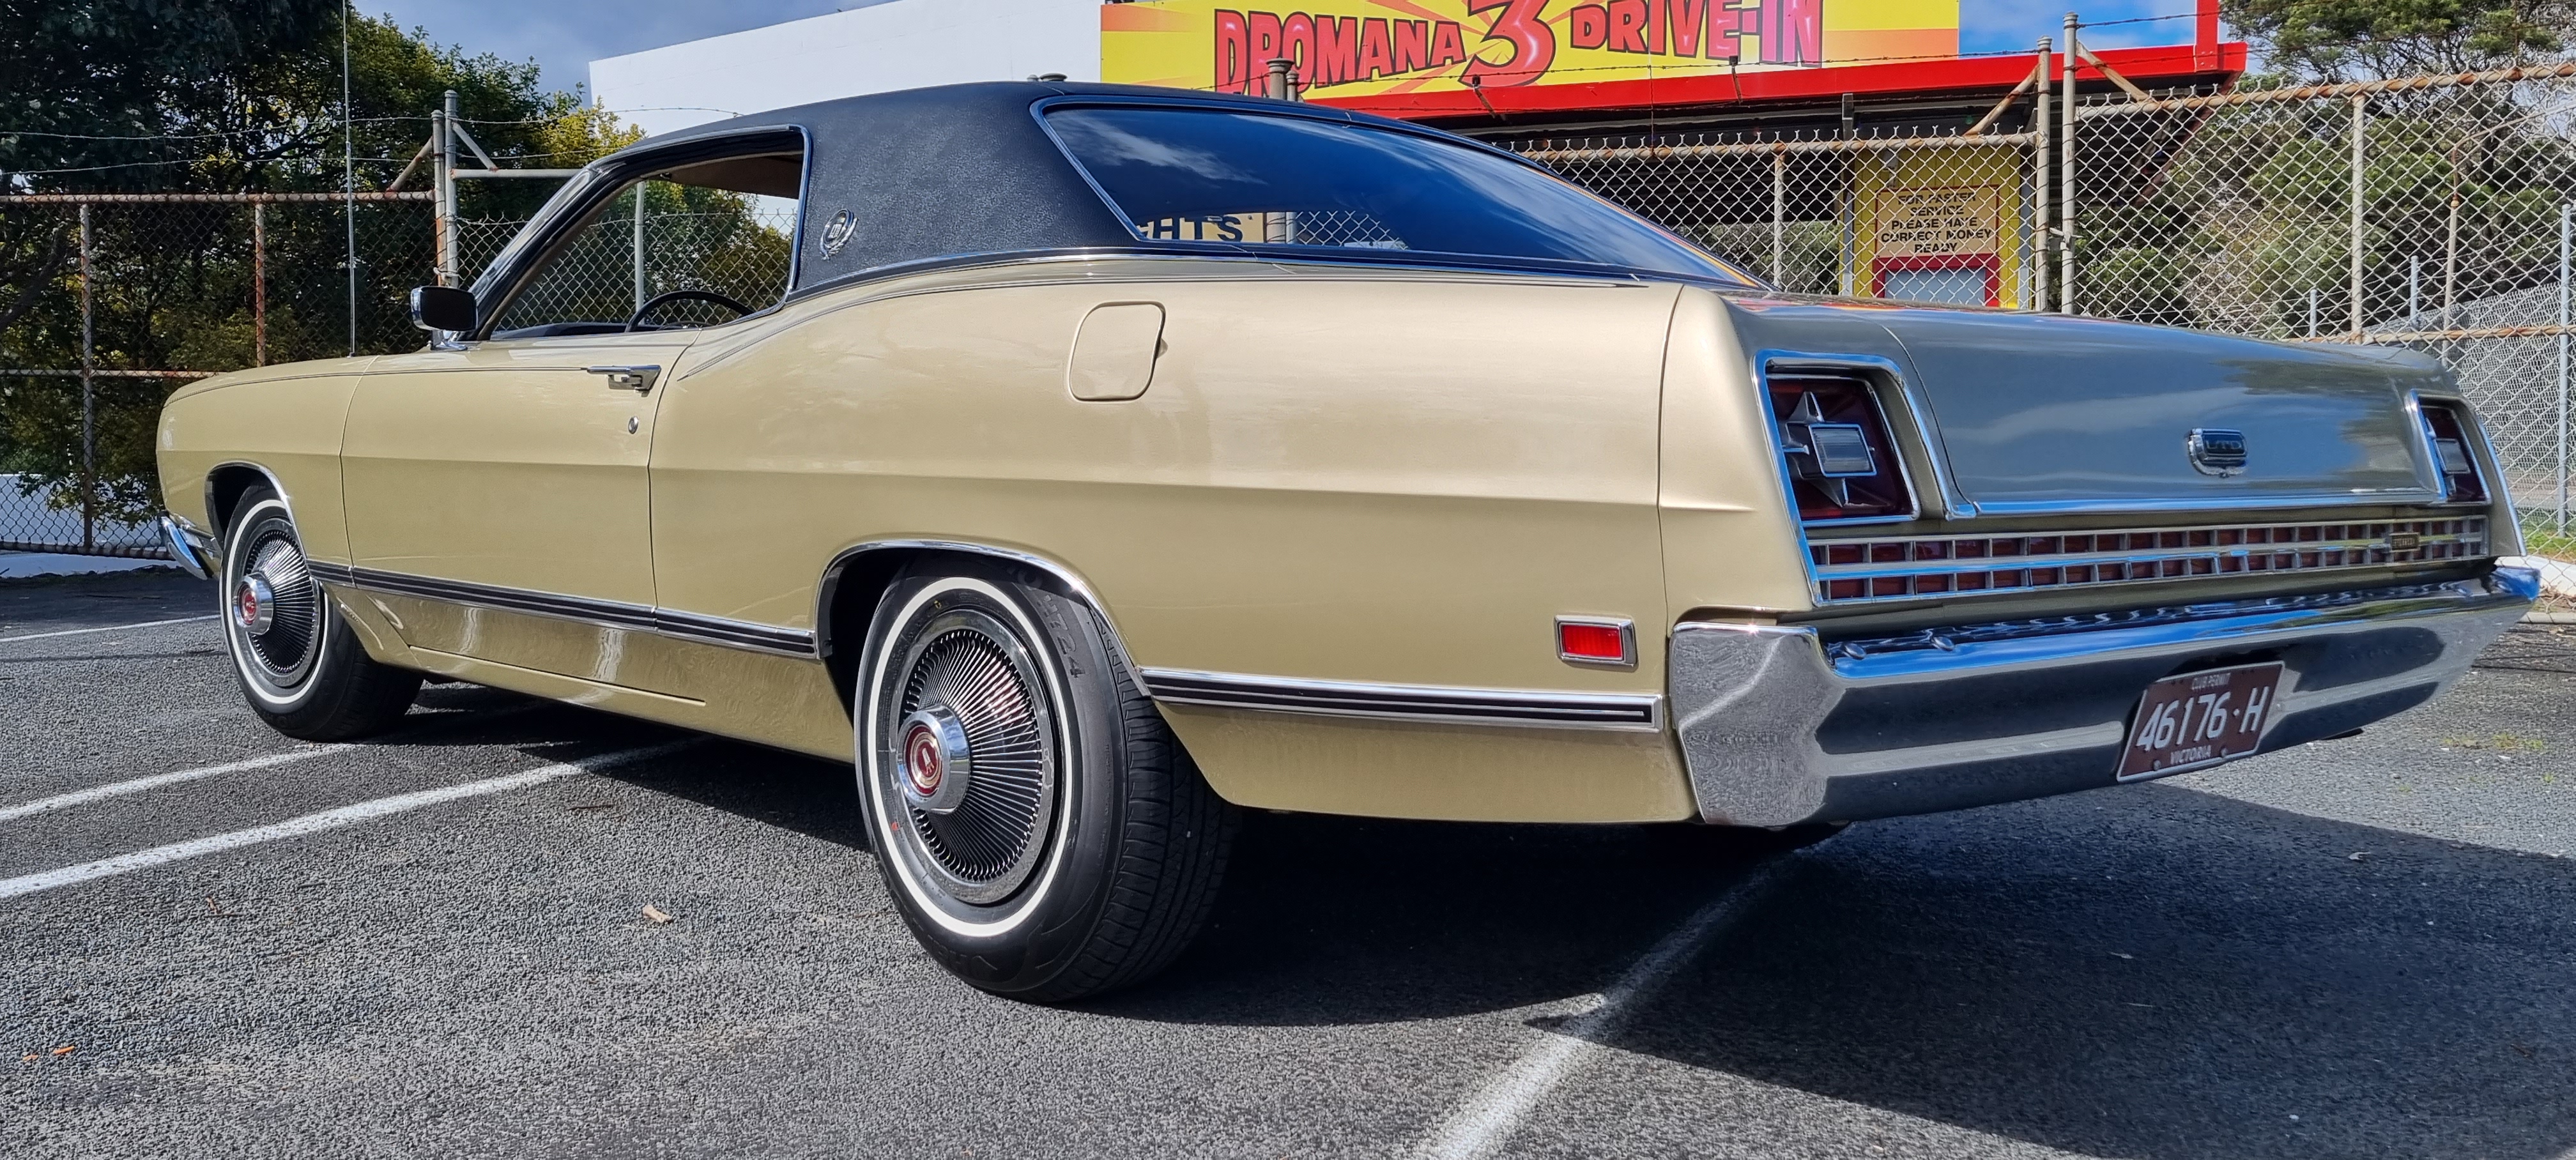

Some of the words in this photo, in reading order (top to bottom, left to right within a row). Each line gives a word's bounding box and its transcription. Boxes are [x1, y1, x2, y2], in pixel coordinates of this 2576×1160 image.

[1215, 9, 1466, 97] DROMANA
[1459, 0, 1556, 88] 3
[1570, 0, 1823, 68] DRIVE-IN
[1898, 195, 1923, 205] FOR
[1928, 192, 1976, 204] FASTER
[1910, 205, 1964, 217] SERVICE
[1891, 218, 1940, 229] PLEASE
[1944, 217, 1978, 227] HAVE
[1881, 231, 1941, 242] CORRECT
[1946, 229, 1992, 240] MONEY
[1914, 243, 1958, 253] READY
[2170, 745, 2212, 765] VICTORIA
